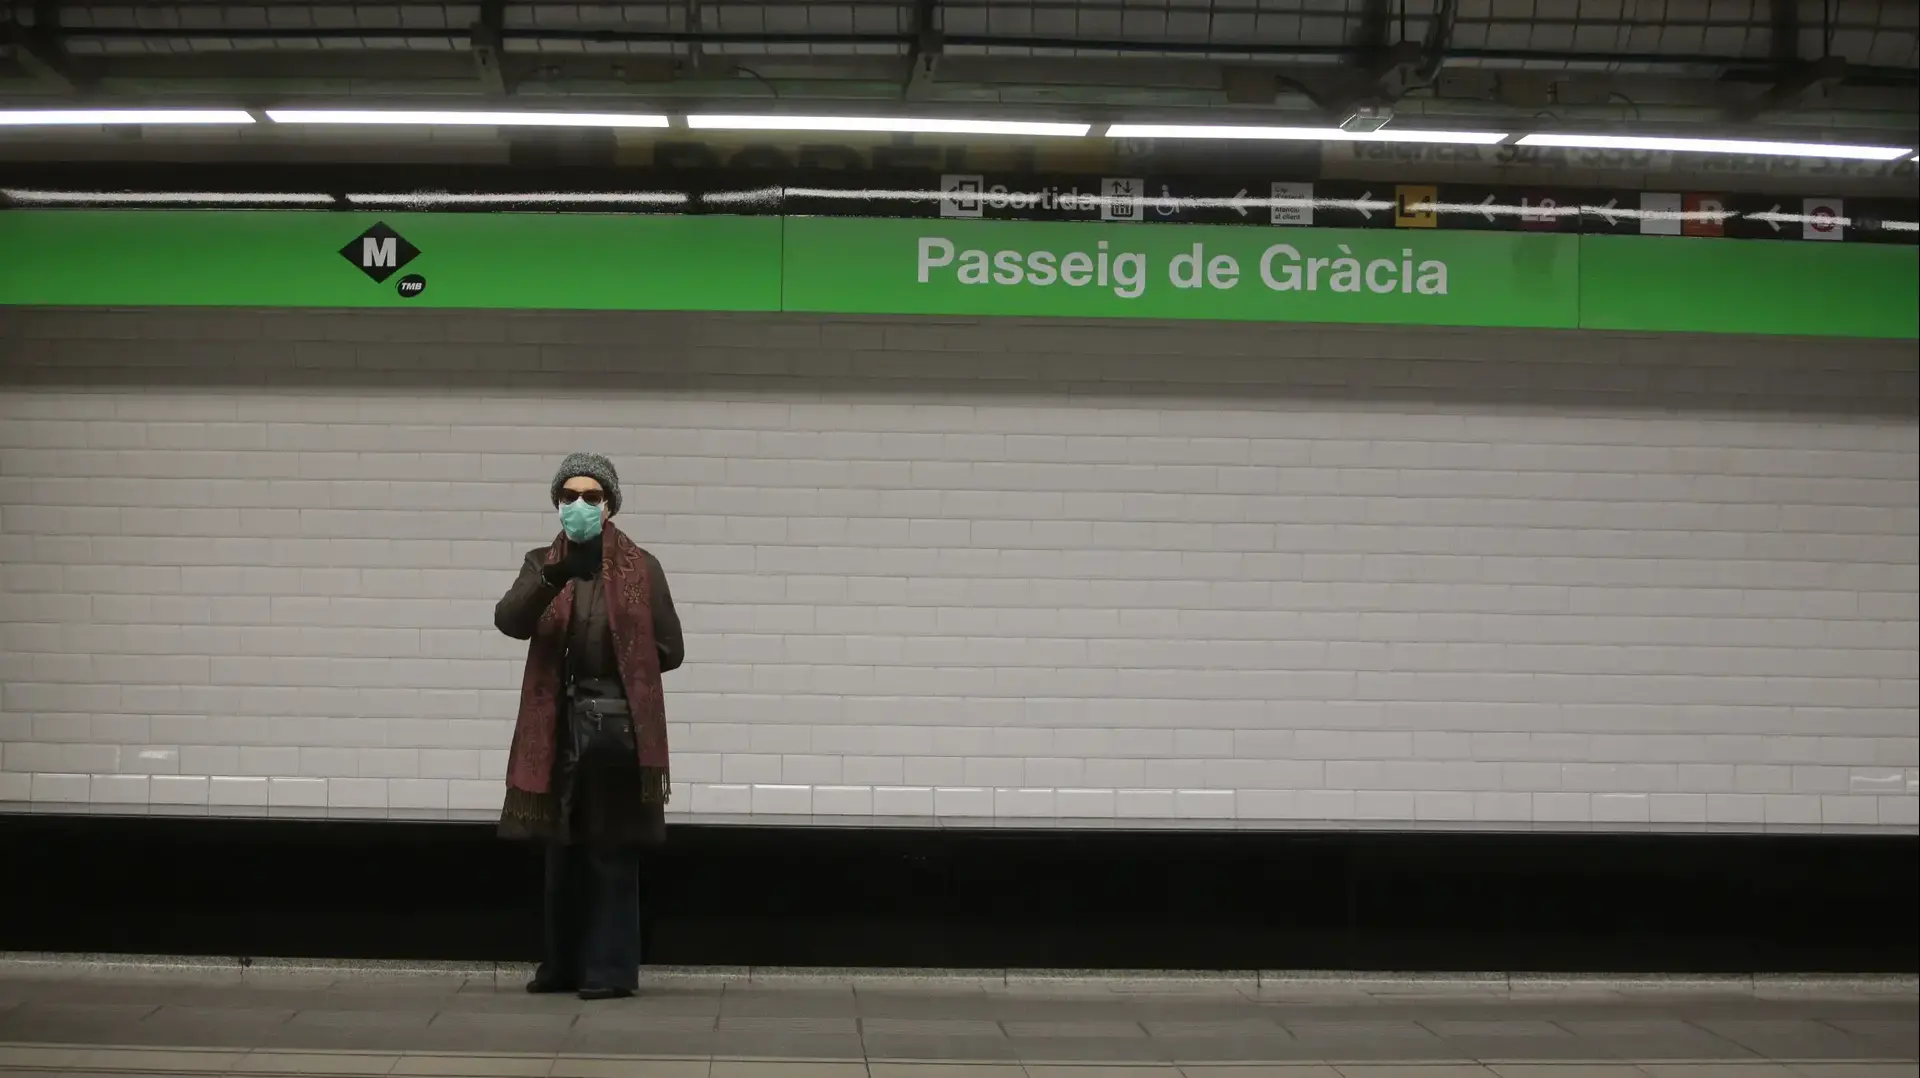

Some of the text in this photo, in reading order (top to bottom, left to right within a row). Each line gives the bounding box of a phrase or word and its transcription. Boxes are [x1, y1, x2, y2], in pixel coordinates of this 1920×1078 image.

[990, 185, 1096, 211] Sortida
[1400, 195, 1430, 218] L4
[1521, 197, 1556, 222] L2
[1699, 200, 1723, 225] R
[363, 237, 396, 267] M
[917, 237, 1448, 298] Passeig de Gràcia
[401, 282, 423, 291] TMB
